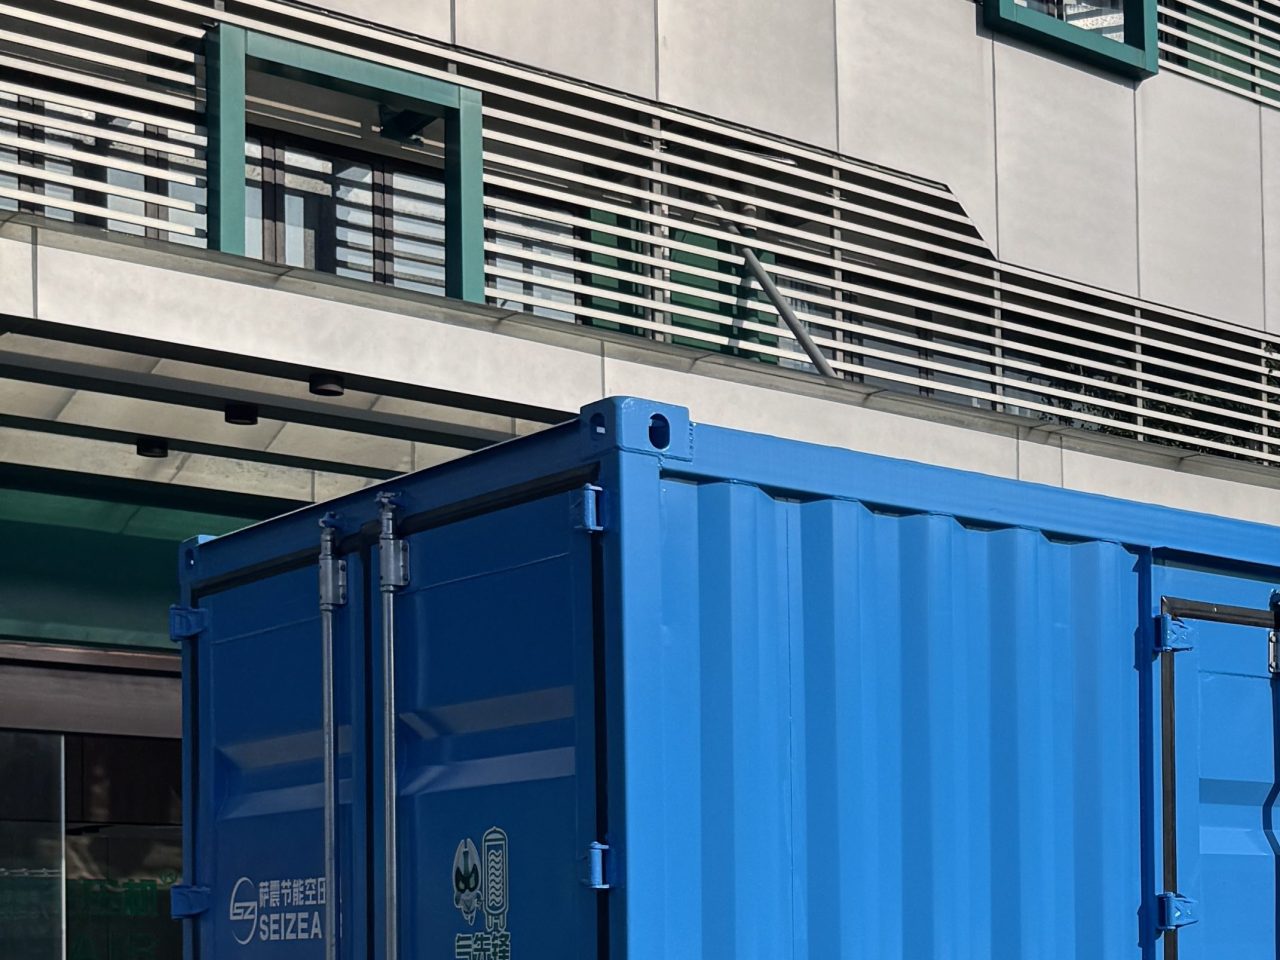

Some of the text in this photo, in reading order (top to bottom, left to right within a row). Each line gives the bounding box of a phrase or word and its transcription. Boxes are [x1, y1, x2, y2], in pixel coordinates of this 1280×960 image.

[258, 877, 326, 908] 萨震节能空压
[259, 911, 323, 942] SEIZEA
